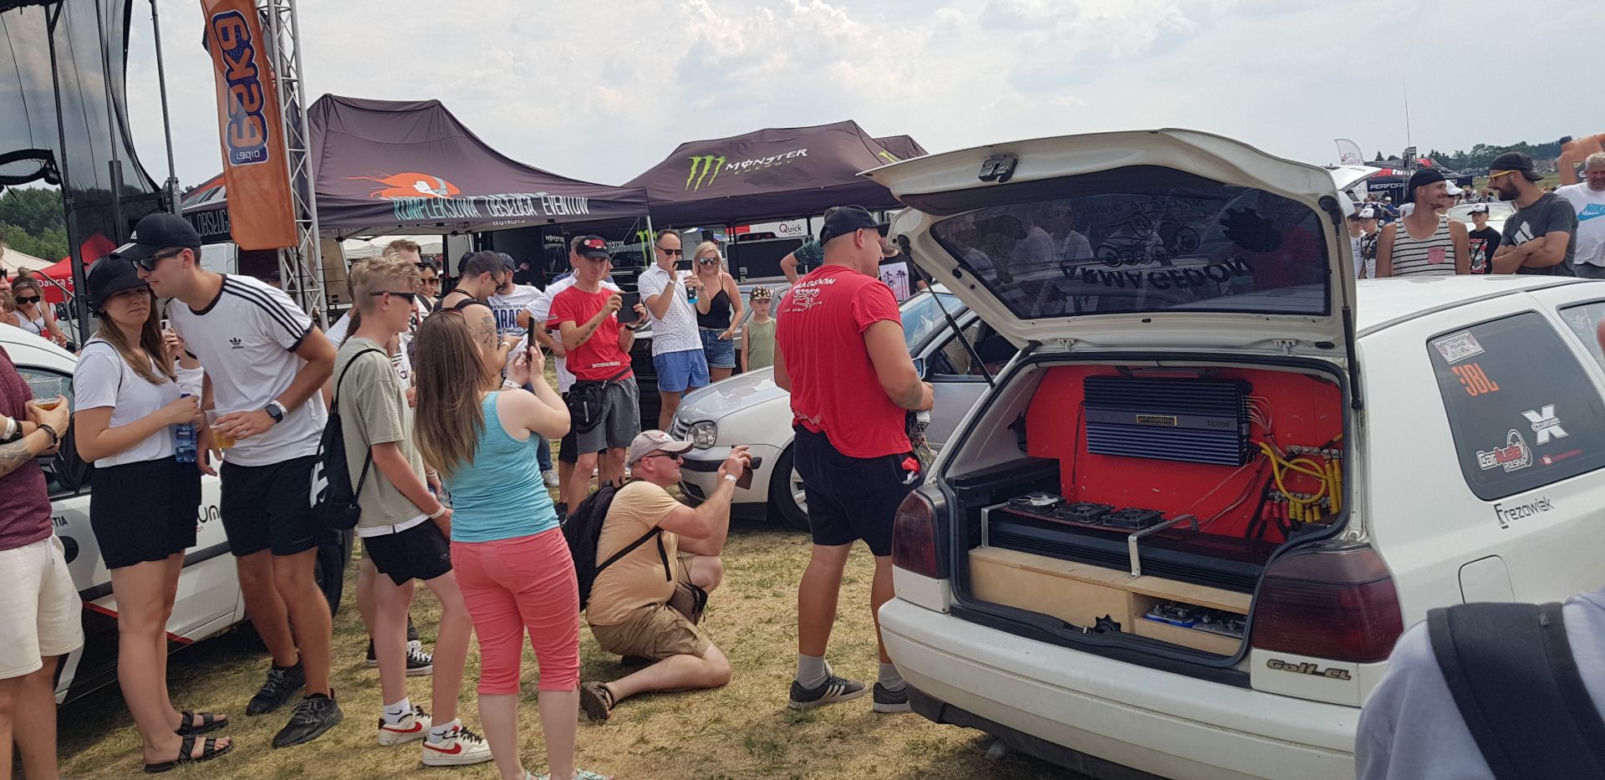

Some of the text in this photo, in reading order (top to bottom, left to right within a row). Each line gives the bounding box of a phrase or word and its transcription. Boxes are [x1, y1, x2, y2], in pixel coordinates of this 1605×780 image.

[725, 148, 808, 171] MONSTER
[389, 196, 482, 221] KOMPLEKSOWA
[779, 223, 802, 233] Quick
[1452, 363, 1499, 396] JBL
[1266, 658, 1319, 675] Golf
